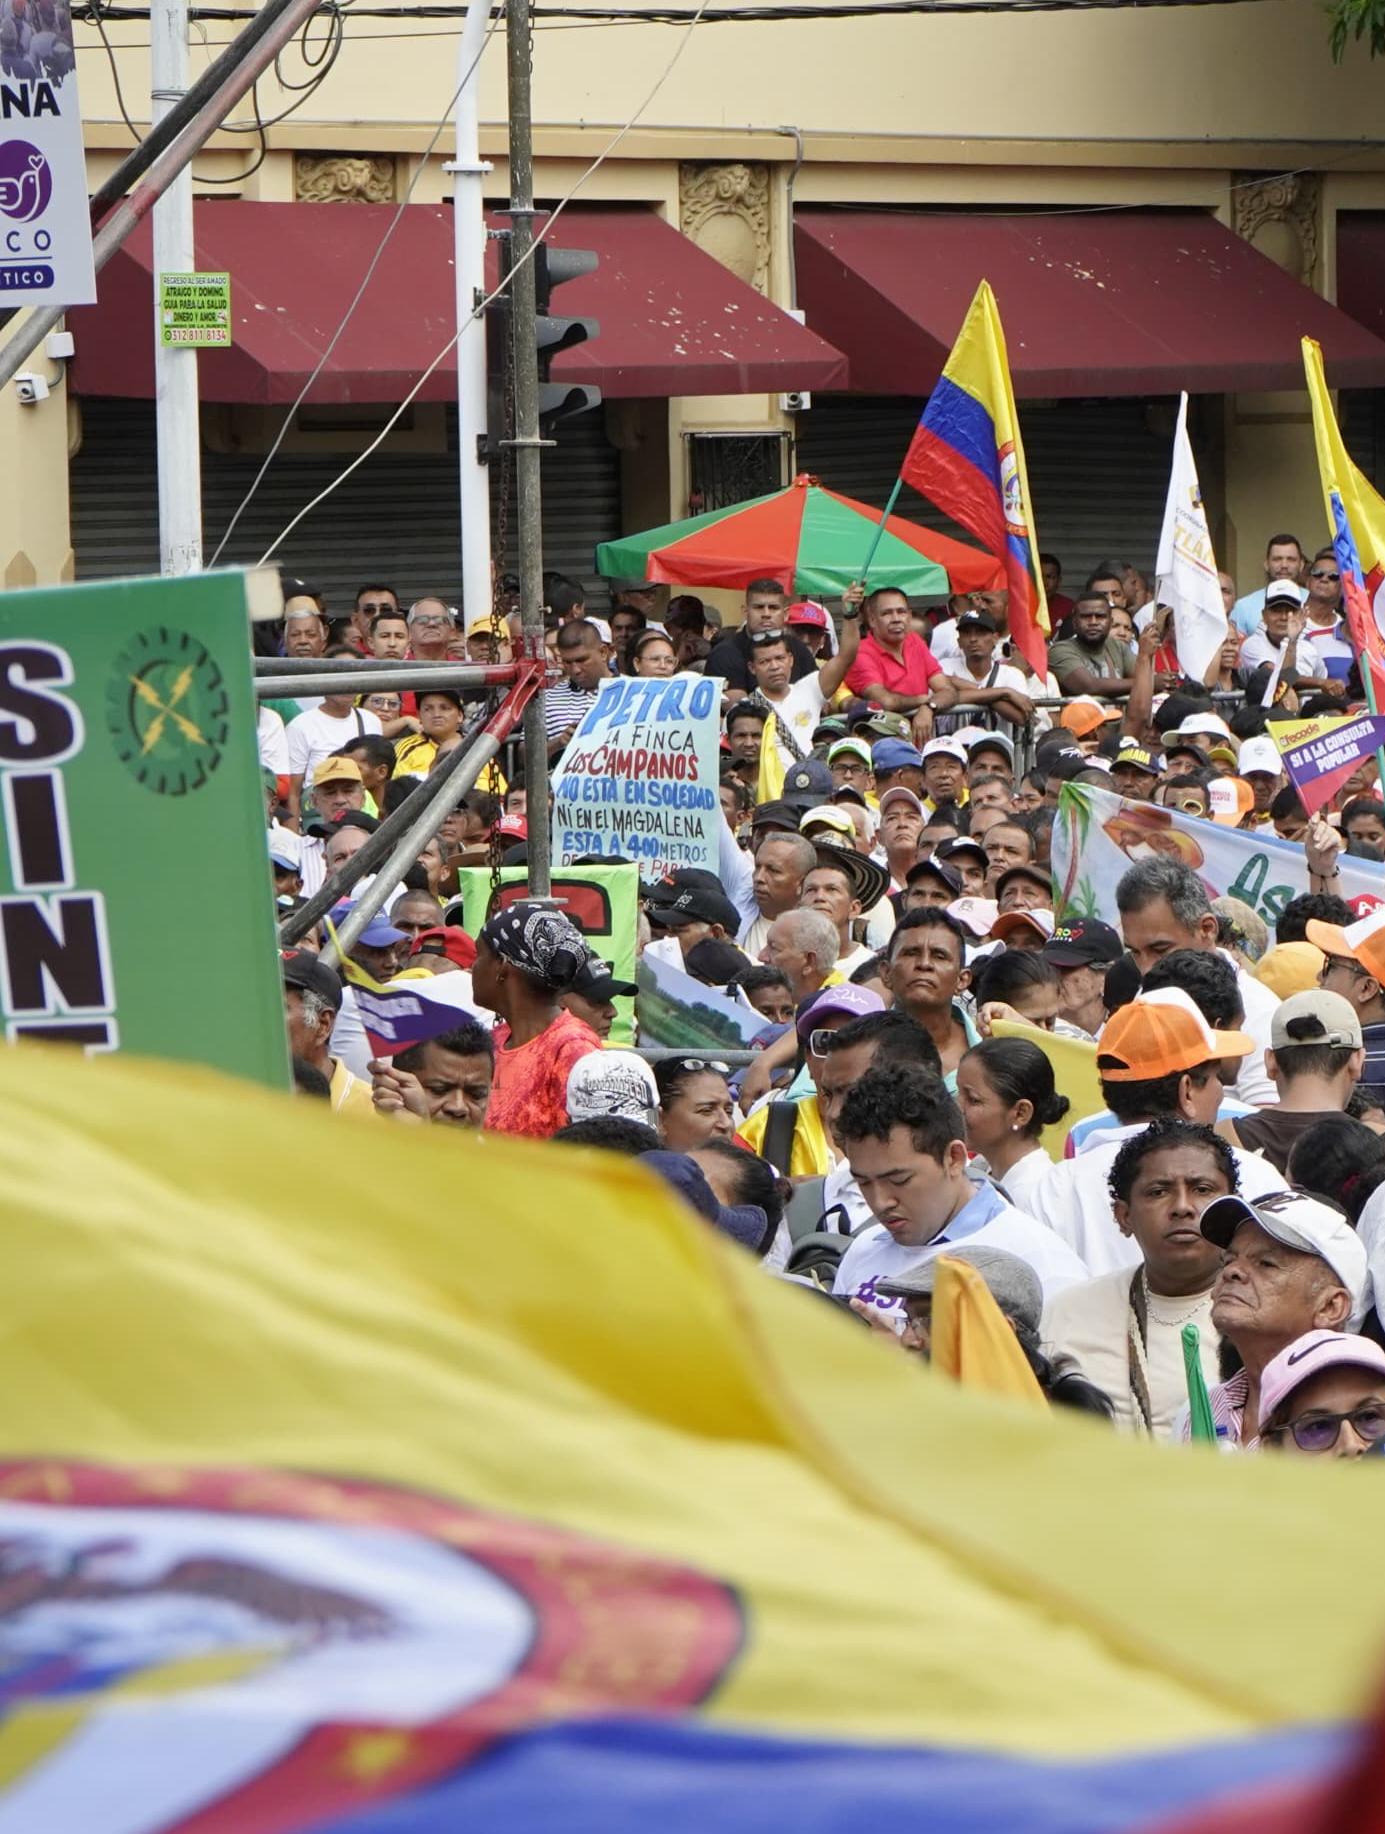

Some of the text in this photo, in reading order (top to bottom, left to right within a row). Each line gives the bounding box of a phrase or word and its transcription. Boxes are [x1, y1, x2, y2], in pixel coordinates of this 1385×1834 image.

[0, 81, 62, 119] NA
[207, 299, 227, 309] SALUD
[172, 330, 226, 341] 312 811 8134
[578, 679, 715, 738] PETRO
[605, 729, 620, 746] LA
[1287, 723, 1320, 745] fecode
[1302, 749, 1313, 763] A
[1310, 742, 1327, 761] LA
[1325, 720, 1376, 751] CONSULTA
[586, 745, 698, 781] CAMPANOS
[1315, 742, 1361, 773] POPULAR
[556, 777, 580, 802] NO
[625, 780, 646, 804] EN
[649, 781, 716, 811] SOLEDAD
[577, 808, 592, 829] EN
[612, 808, 705, 842] MAGDALENA
[609, 835, 623, 854] A
[627, 834, 660, 859] 400
[659, 840, 708, 862] METROS
